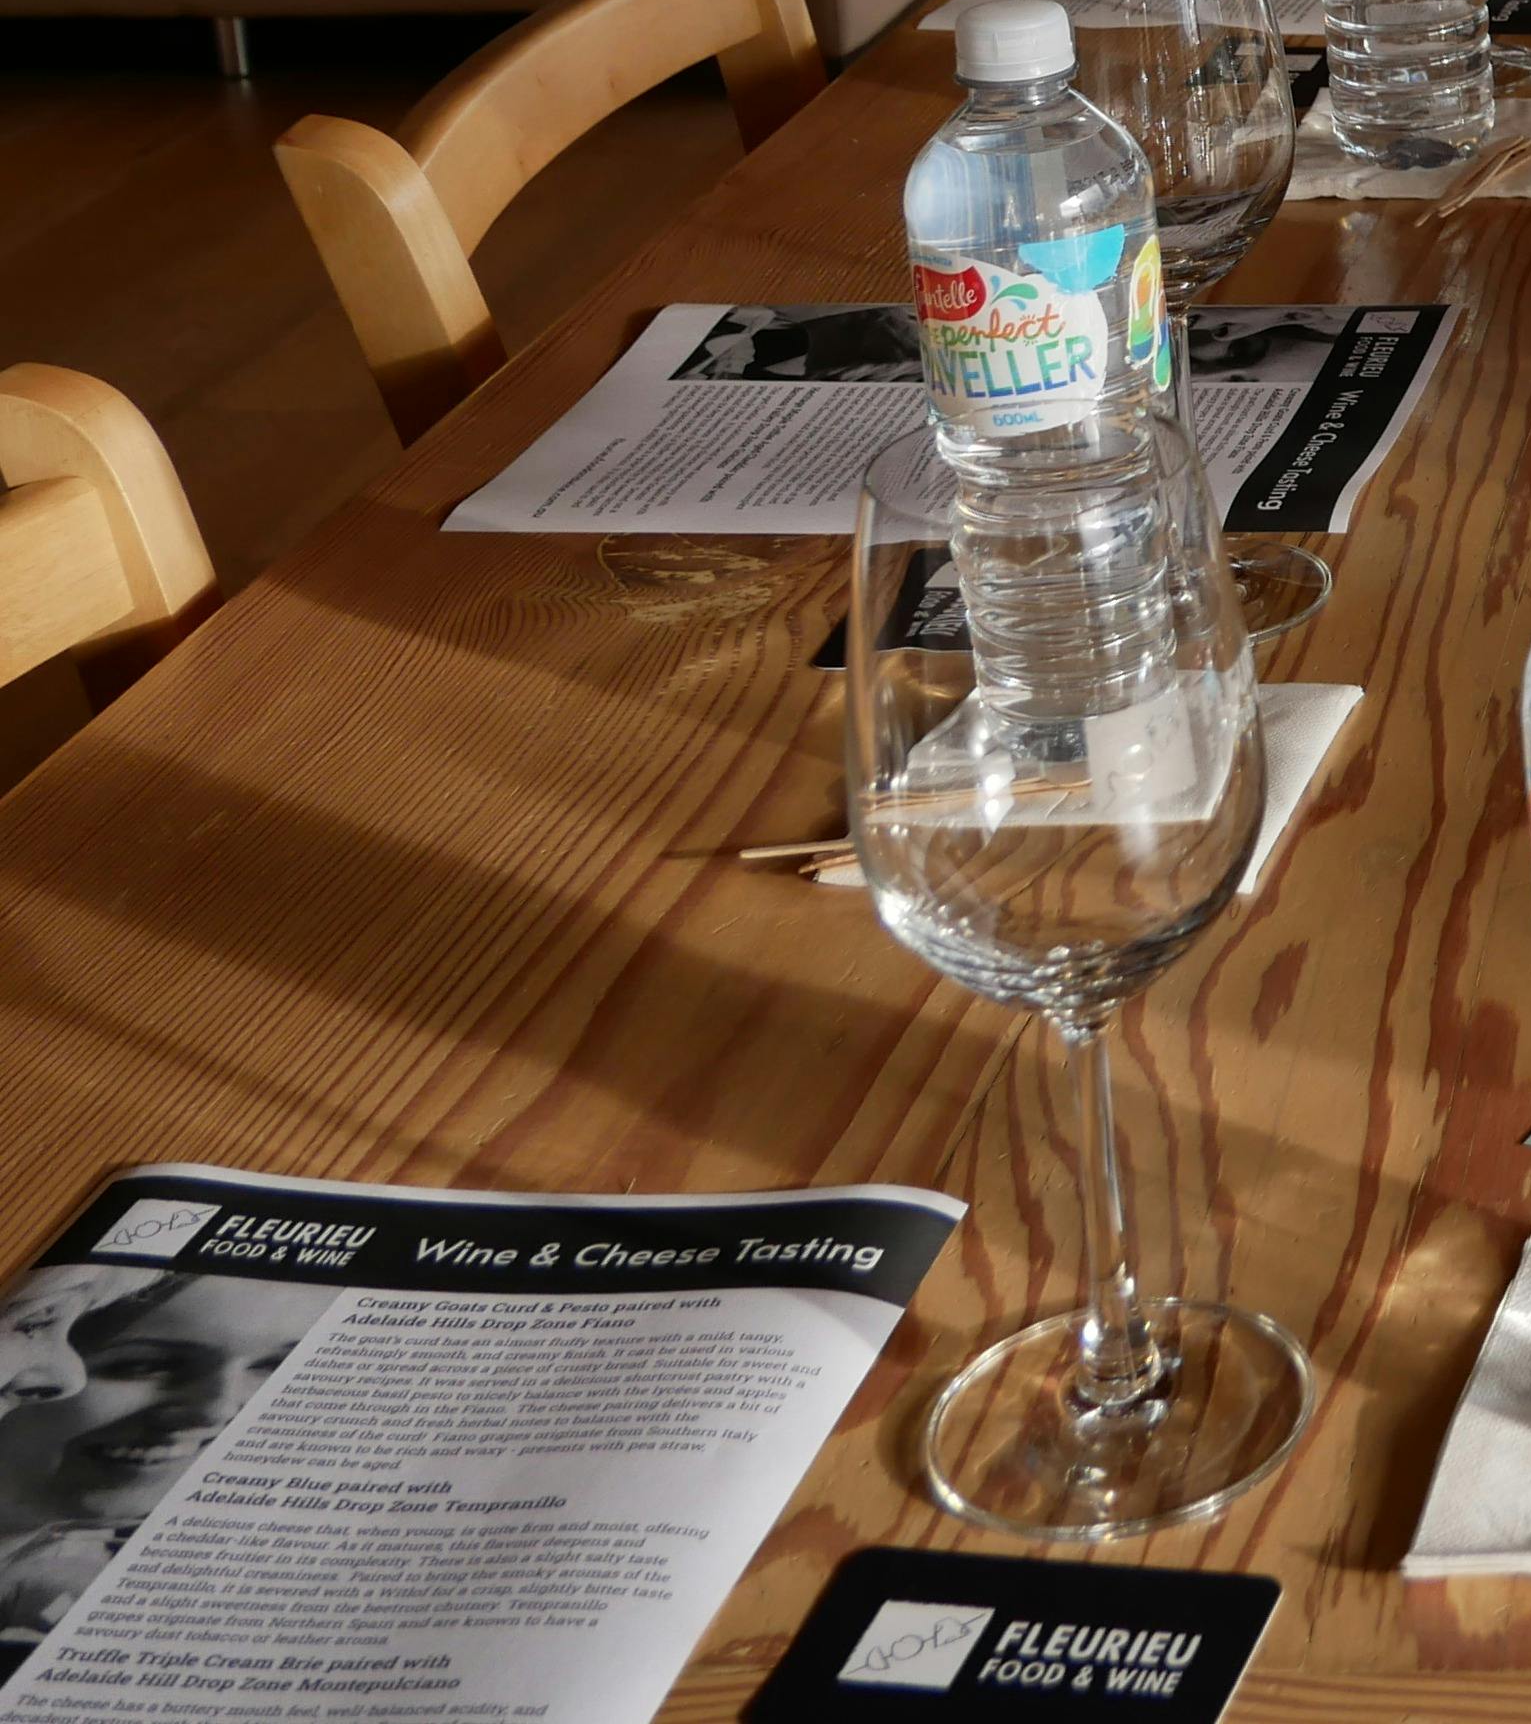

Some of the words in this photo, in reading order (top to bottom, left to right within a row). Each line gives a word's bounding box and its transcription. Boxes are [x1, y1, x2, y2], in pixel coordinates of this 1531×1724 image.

[940, 303, 1066, 354] perfect
[1324, 389, 1364, 420] Wine
[1319, 422, 1345, 431] &
[1292, 432, 1338, 467] Cheese
[1257, 467, 1313, 512] Tasting
[216, 1215, 376, 1248] FLEURIEU
[200, 1238, 267, 1259] FOOD
[270, 1246, 288, 1262] &
[296, 1248, 355, 1267] WINE
[416, 1236, 518, 1265] Wine
[529, 1242, 561, 1267] &
[575, 1242, 720, 1268] Cheese
[735, 1237, 885, 1270] Tasting
[357, 1297, 432, 1313] Creamy
[435, 1300, 486, 1313] Goats
[491, 1302, 539, 1314] Curd
[541, 1301, 554, 1313] &
[558, 1302, 610, 1313] Pesto
[612, 1299, 676, 1314] paired
[680, 1297, 721, 1309] with
[342, 1313, 427, 1327] Adelaide
[431, 1315, 476, 1329] Hills
[482, 1319, 526, 1333] Drop
[529, 1319, 578, 1329] Zone
[581, 1317, 635, 1329] Fiano
[201, 1471, 282, 1490] Creamy
[287, 1478, 331, 1493] Blue
[334, 1480, 402, 1495] paired
[406, 1480, 453, 1494] with
[185, 1490, 278, 1507] Adelaide
[283, 1494, 329, 1510] Hills
[334, 1498, 385, 1514] Drop
[388, 1501, 438, 1513] Zone
[445, 1496, 567, 1513] Tempranillo
[994, 1620, 1202, 1668] FLEURIEU
[56, 1647, 131, 1664] Truffle
[139, 1650, 199, 1669] Triple
[203, 1654, 272, 1670] Cream
[280, 1656, 323, 1670] Brie
[327, 1655, 397, 1673] paired
[403, 1654, 451, 1670] with
[35, 1667, 133, 1685] Adelaide
[137, 1673, 177, 1690] Hill
[181, 1675, 235, 1692] Drop
[238, 1677, 292, 1691] Zone
[296, 1675, 460, 1695] Montepulciano
[978, 1657, 1067, 1685] FOOD
[1071, 1664, 1094, 1688] &
[1105, 1667, 1183, 1695] WINE
